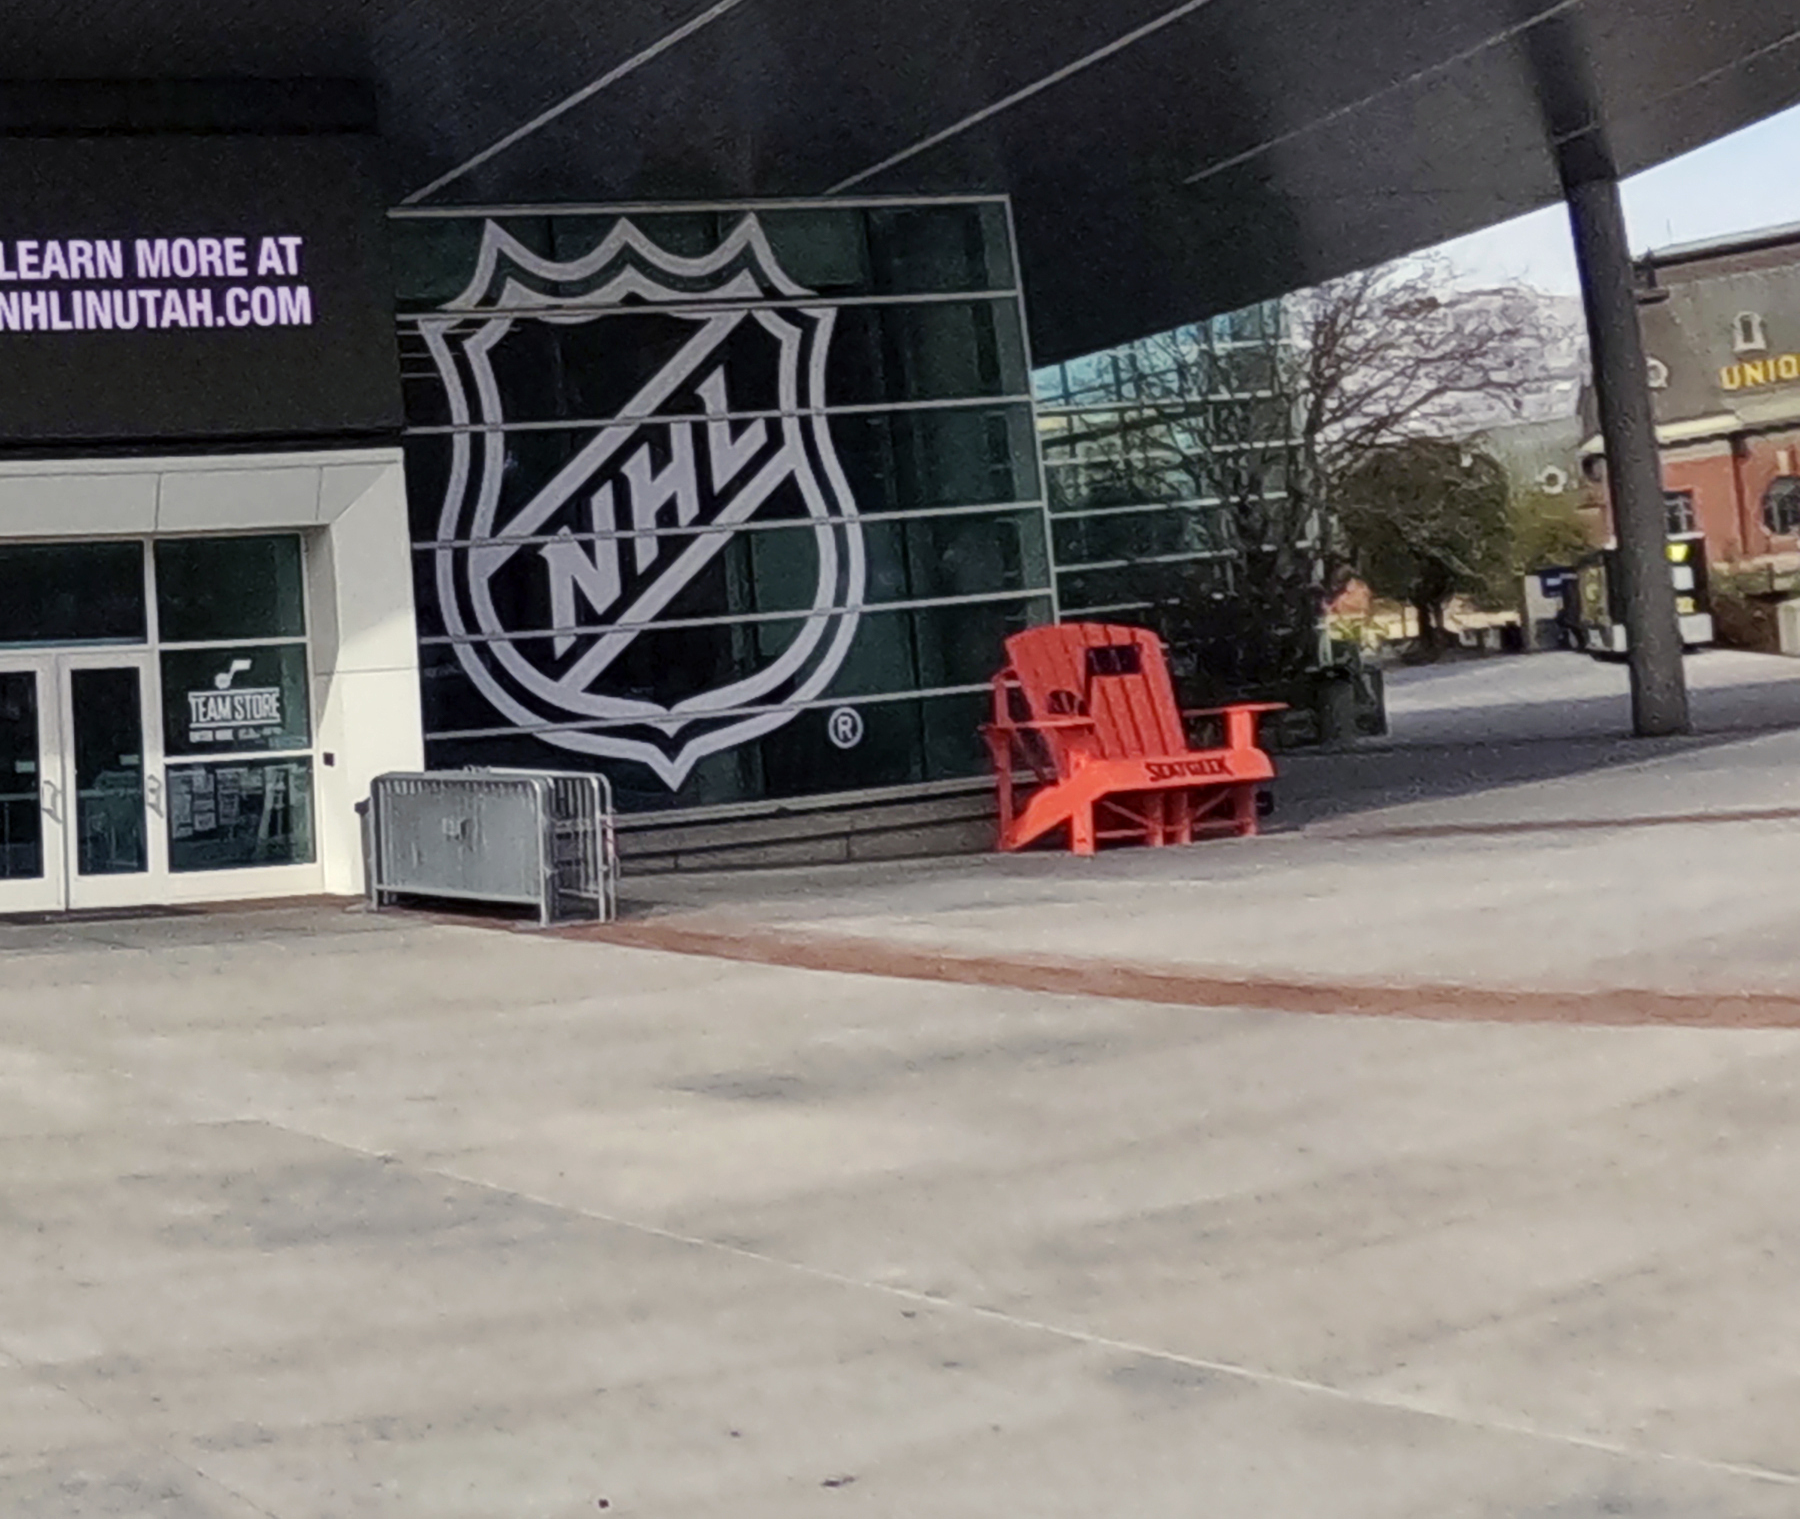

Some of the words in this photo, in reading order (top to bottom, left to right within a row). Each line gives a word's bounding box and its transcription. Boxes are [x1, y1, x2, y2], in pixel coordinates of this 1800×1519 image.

[135, 237, 249, 279] MORE
[256, 235, 303, 277] AT
[537, 363, 768, 661] NHL
[188, 693, 233, 724] TEAM
[234, 691, 281, 722] STORE
